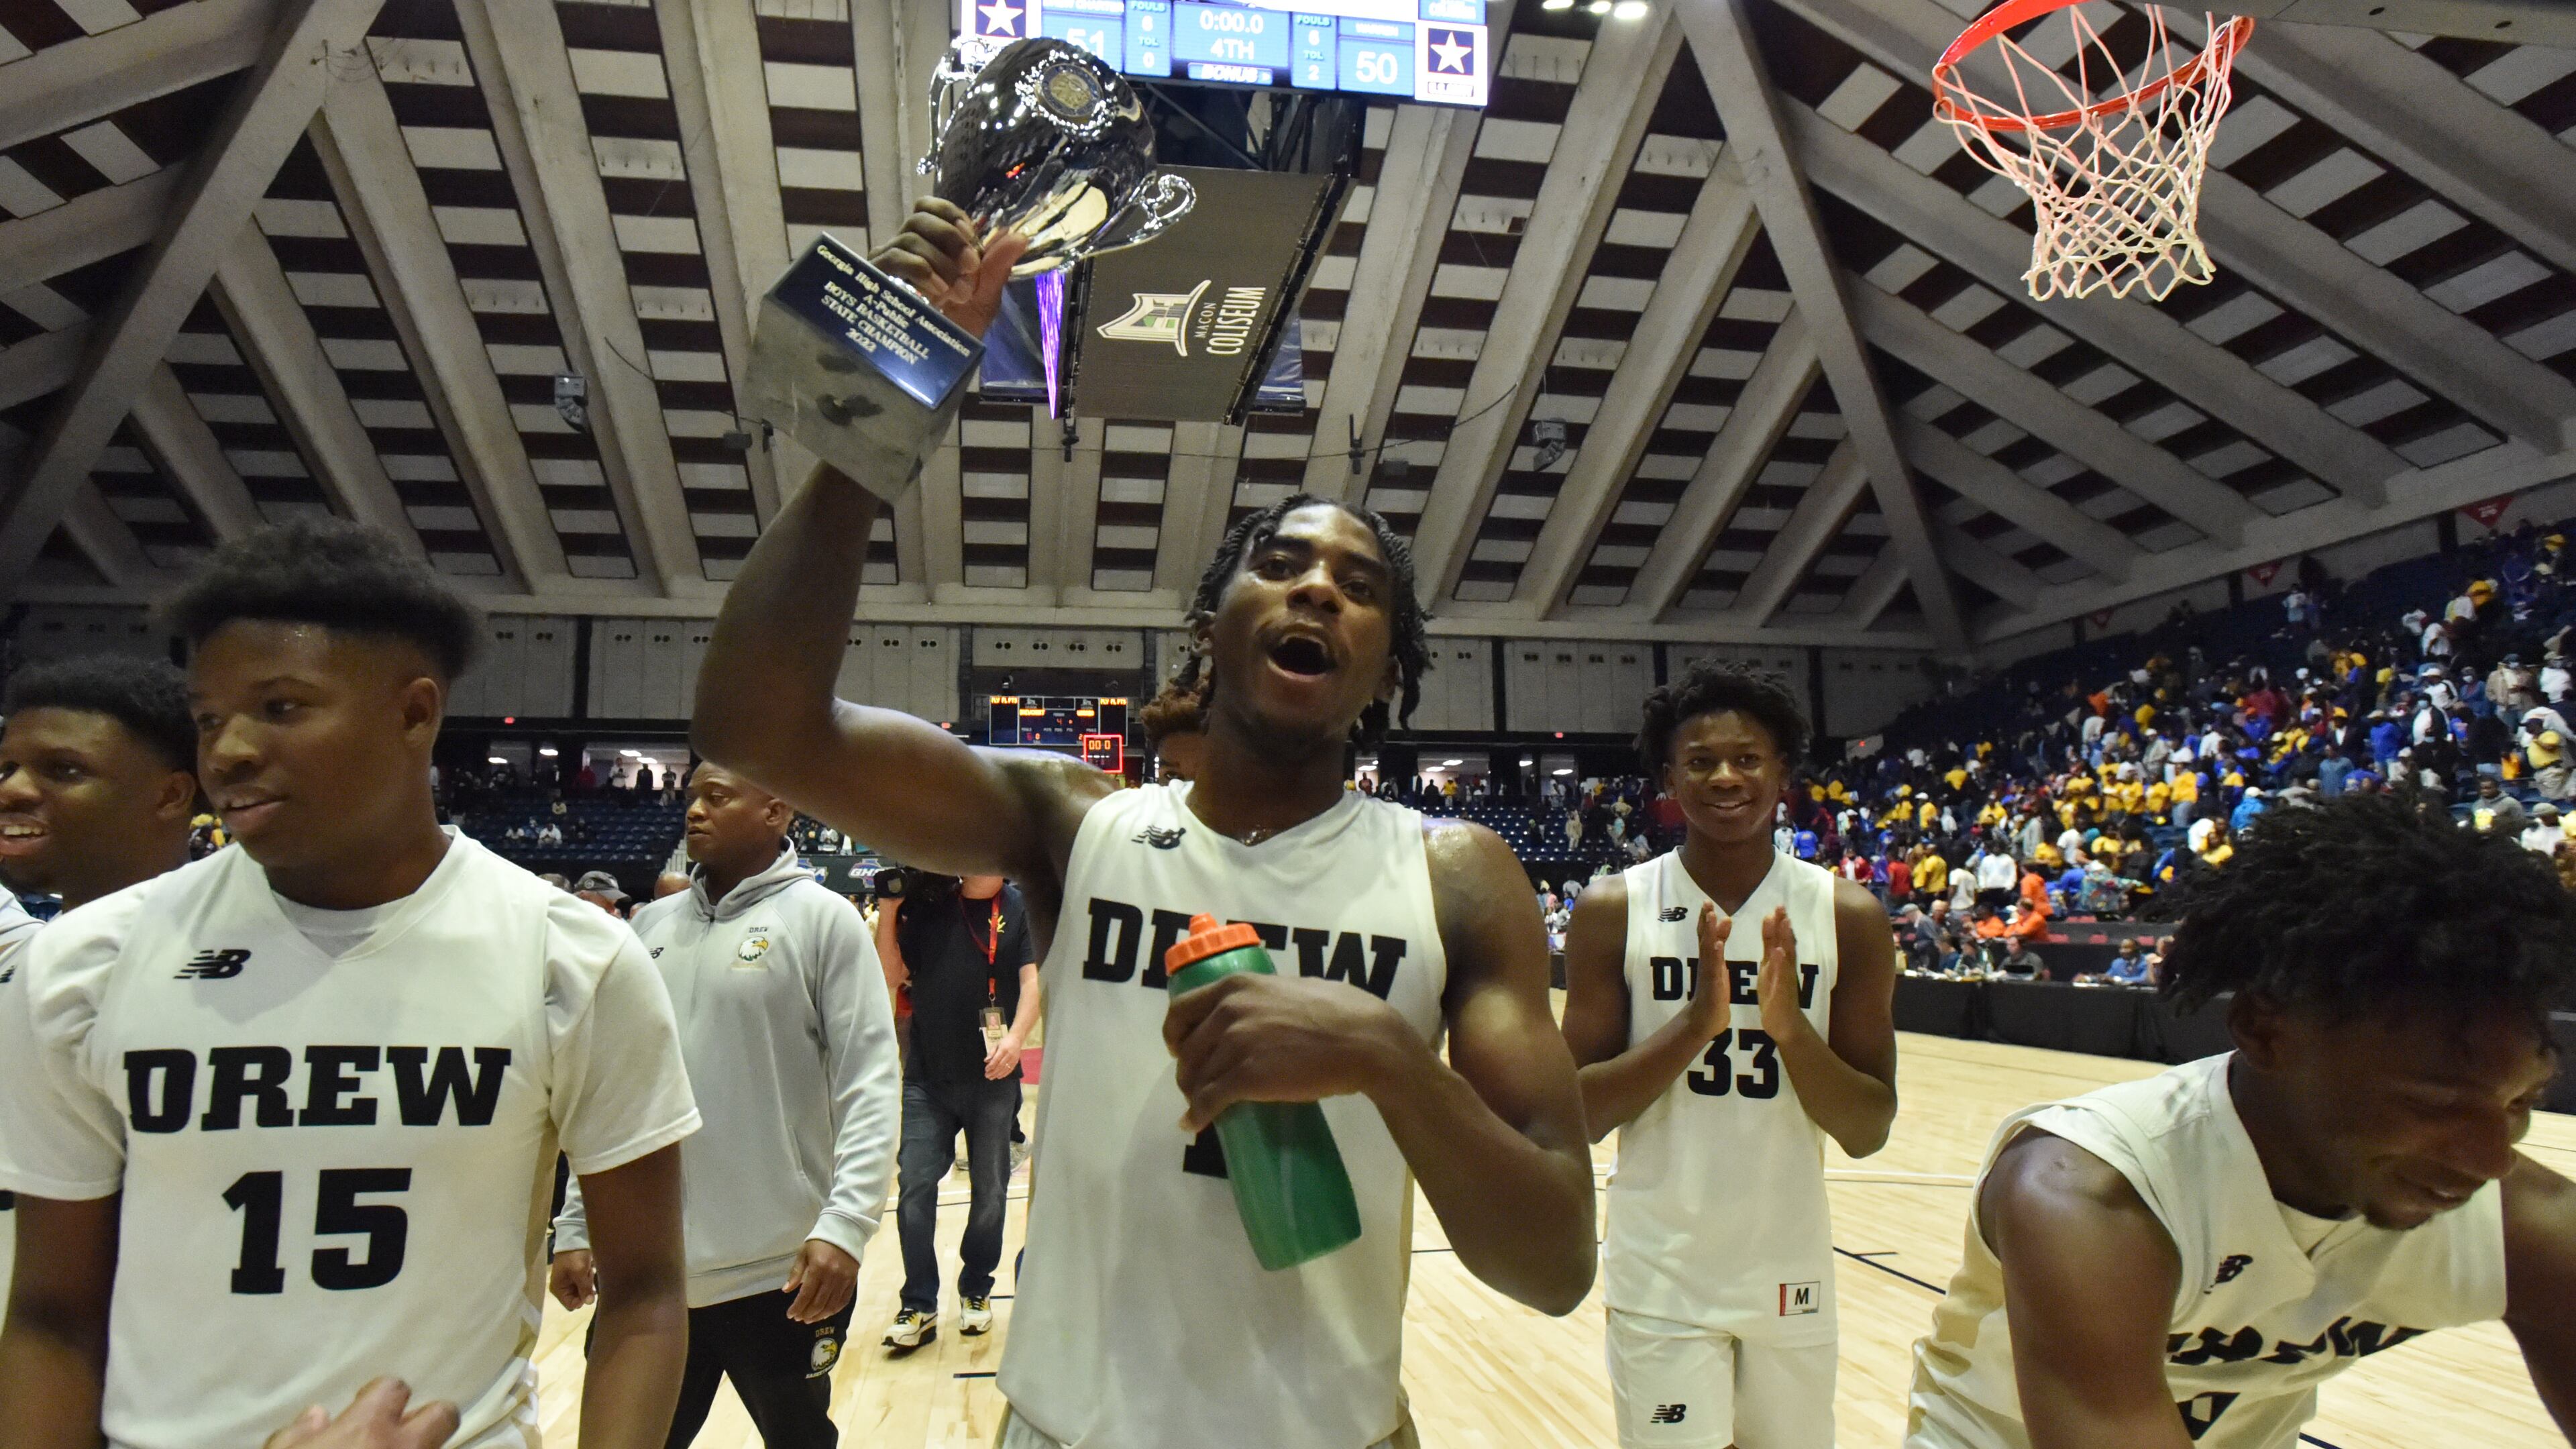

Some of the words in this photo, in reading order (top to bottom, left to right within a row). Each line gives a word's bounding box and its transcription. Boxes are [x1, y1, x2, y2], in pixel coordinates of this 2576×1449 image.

[1130, 1, 1165, 11] FOULS
[1199, 9, 1264, 34] 0:00.0
[1296, 15, 1331, 26] FOULS
[1067, 28, 1104, 61] 51
[1138, 36, 1159, 46] TOL
[1210, 38, 1254, 60] 4TH
[1303, 50, 1324, 60] TOL
[1143, 52, 1155, 68] 0
[1201, 64, 1258, 83] BONUS
[1307, 64, 1320, 80] 2
[1356, 50, 1399, 85] 50
[817, 245, 855, 276] Georgia
[855, 272, 880, 293] High
[881, 290, 916, 318] School
[917, 317, 970, 357] Association
[863, 294, 910, 329] A-Public
[820, 294, 859, 324] STATE
[857, 320, 919, 365] CHAMPION
[824, 280, 858, 307] BOYS
[855, 305, 930, 360] BASKETBALL
[1193, 302, 1216, 338] MACON
[1206, 287, 1266, 355] COLISEUM
[1083, 898, 1406, 1001] DW
[1650, 957, 1819, 1009] DE
[1687, 1028, 1779, 1099] 33
[123, 1045, 512, 1132] DREW
[222, 1167, 413, 1295] 15
[1794, 1287, 1809, 1305] M
